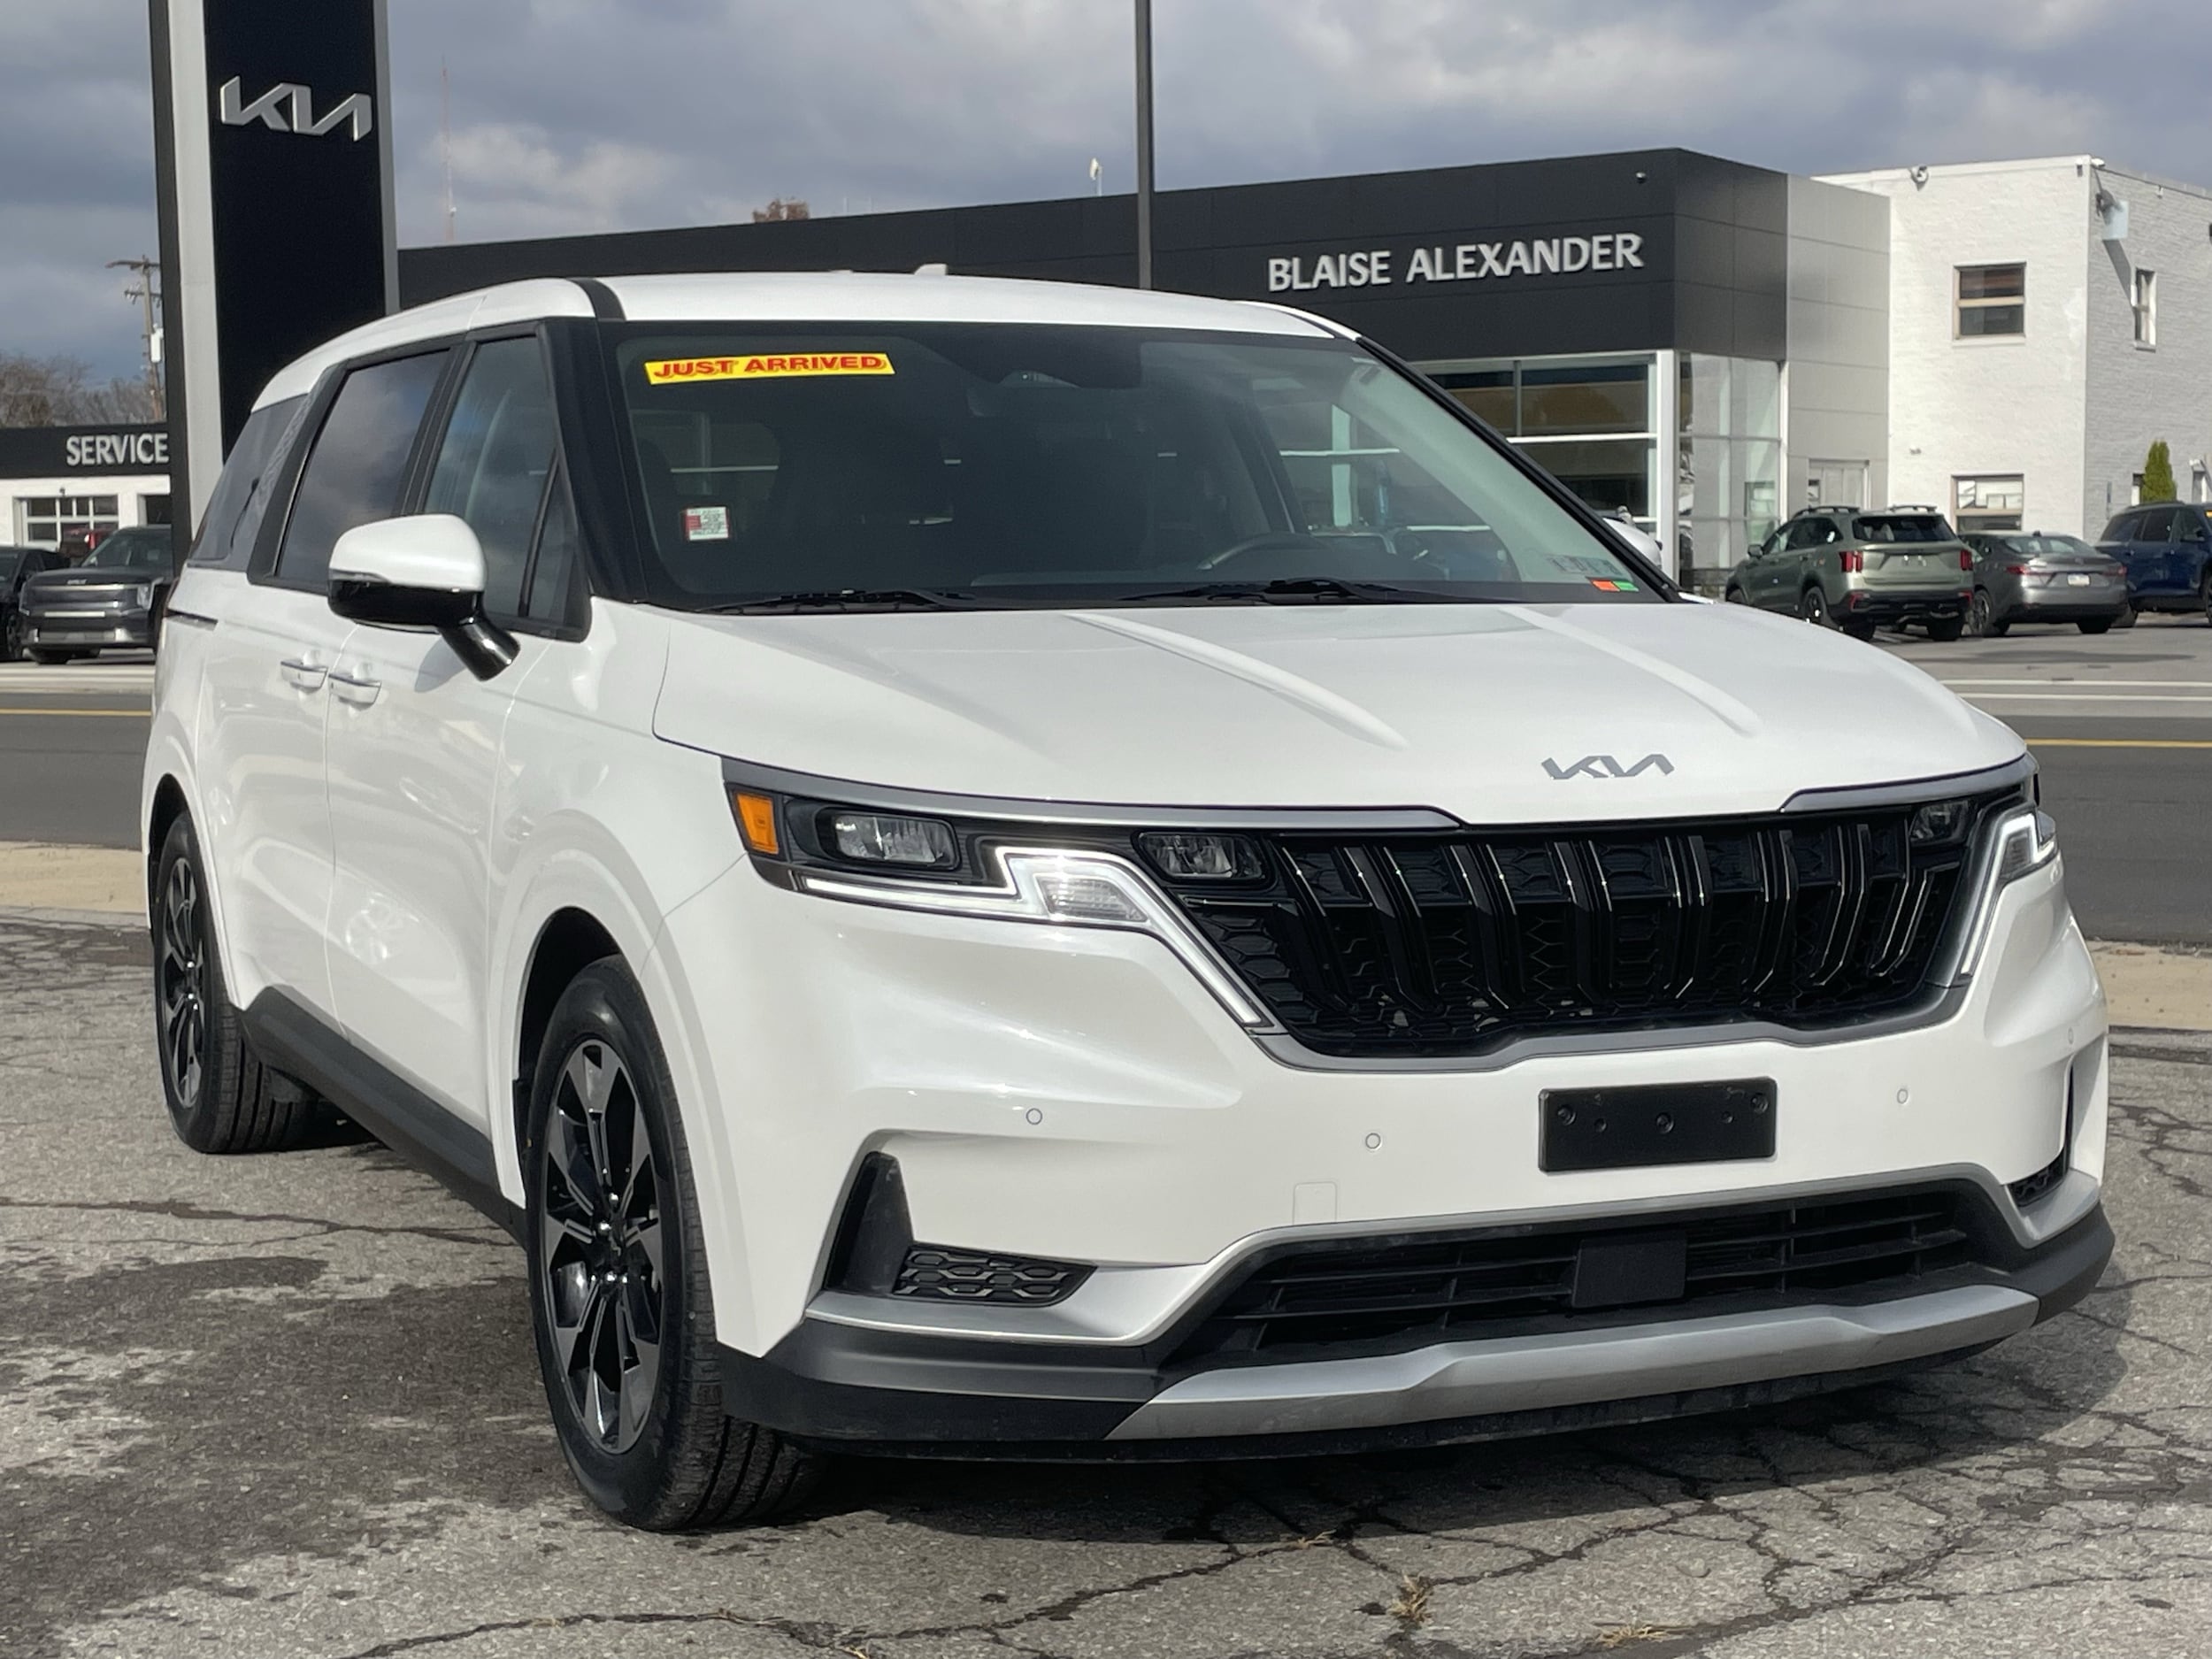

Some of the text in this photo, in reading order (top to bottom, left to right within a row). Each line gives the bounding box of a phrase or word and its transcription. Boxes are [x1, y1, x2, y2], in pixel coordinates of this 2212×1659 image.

[220, 76, 373, 142] KIA
[1269, 233, 1644, 292] BLAISE ALEXANDER
[653, 356, 886, 379] JUST ARRIVED
[66, 433, 169, 466] SERVICE
